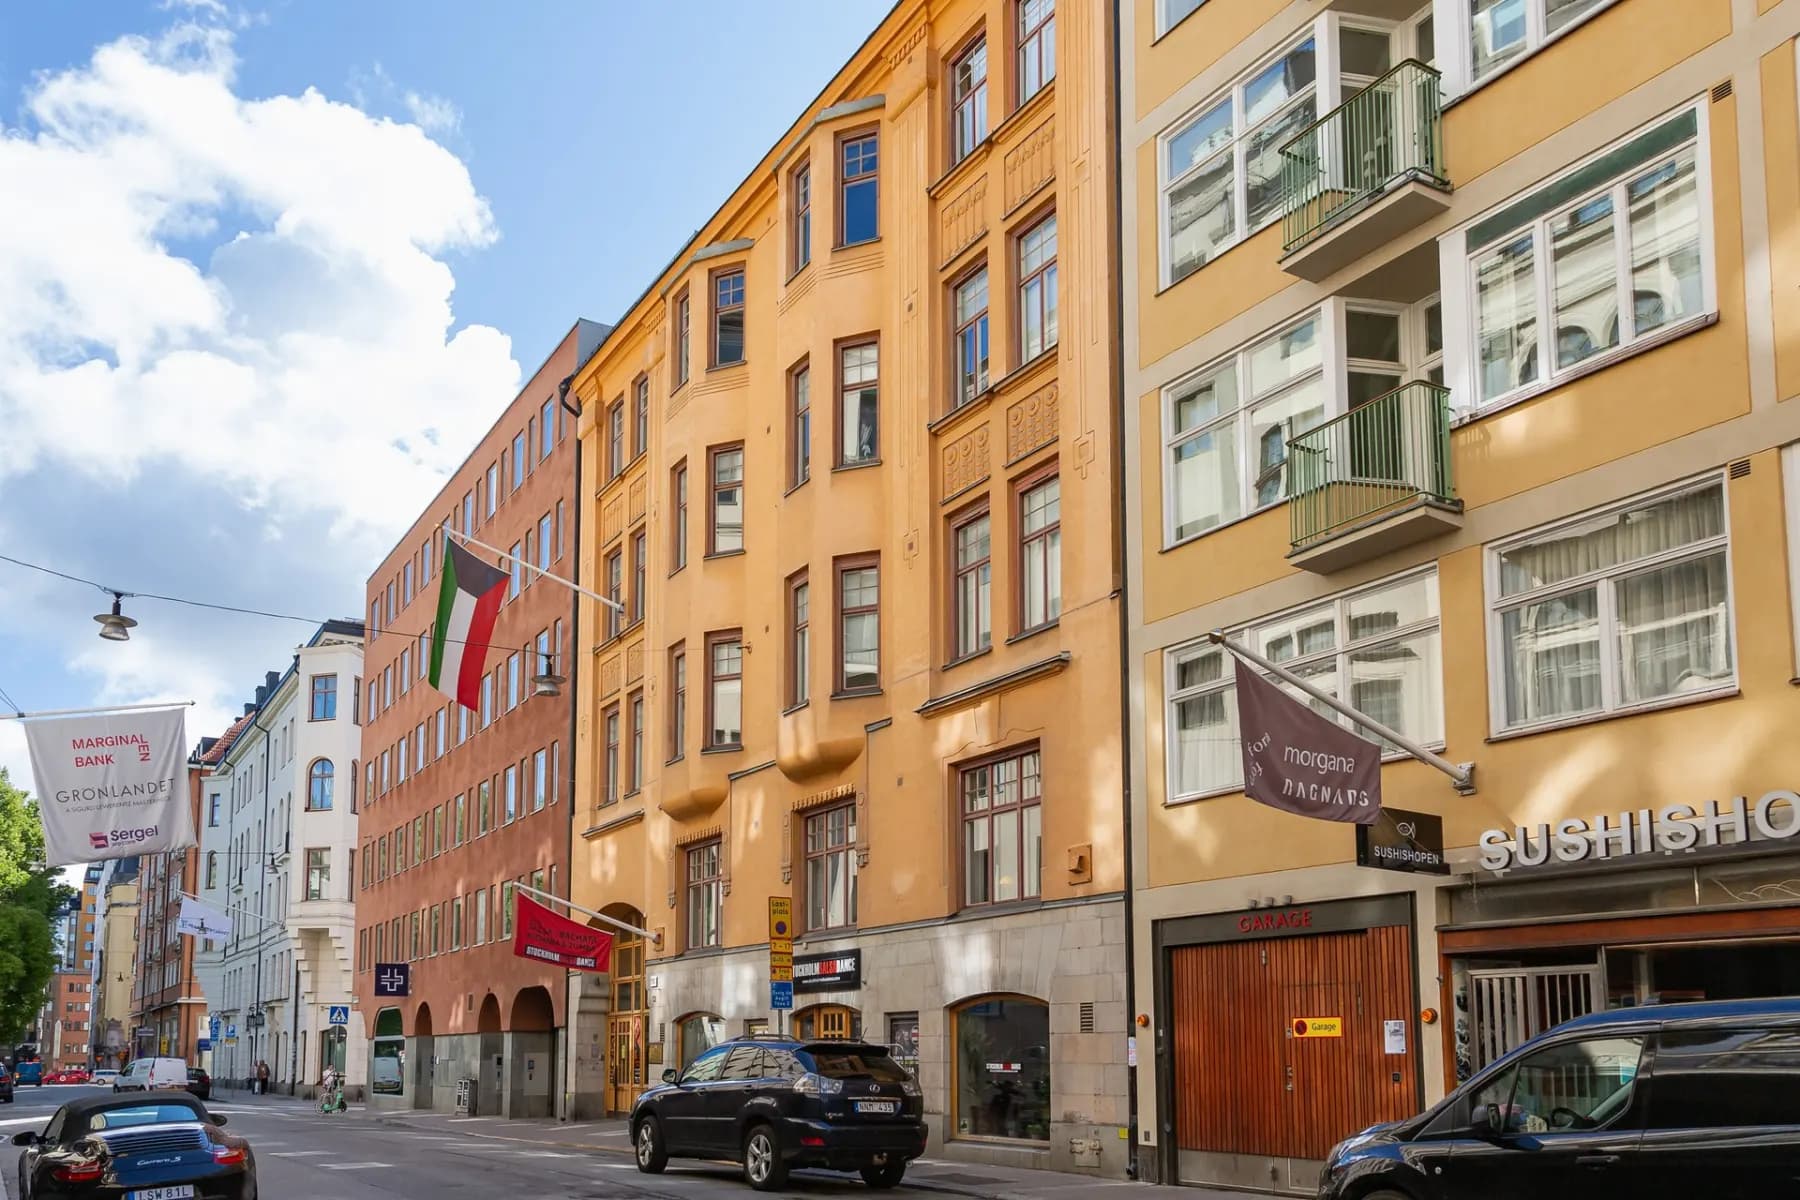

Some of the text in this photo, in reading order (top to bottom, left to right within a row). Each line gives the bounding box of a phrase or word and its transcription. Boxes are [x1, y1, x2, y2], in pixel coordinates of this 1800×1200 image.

[75, 754, 114, 768] BANK
[1284, 745, 1355, 775] morgana
[110, 825, 159, 841] Sergel
[1374, 845, 1439, 865] SUSHISHOPEN
[1237, 908, 1313, 933] GARAGE
[1311, 1022, 1337, 1032] Garage
